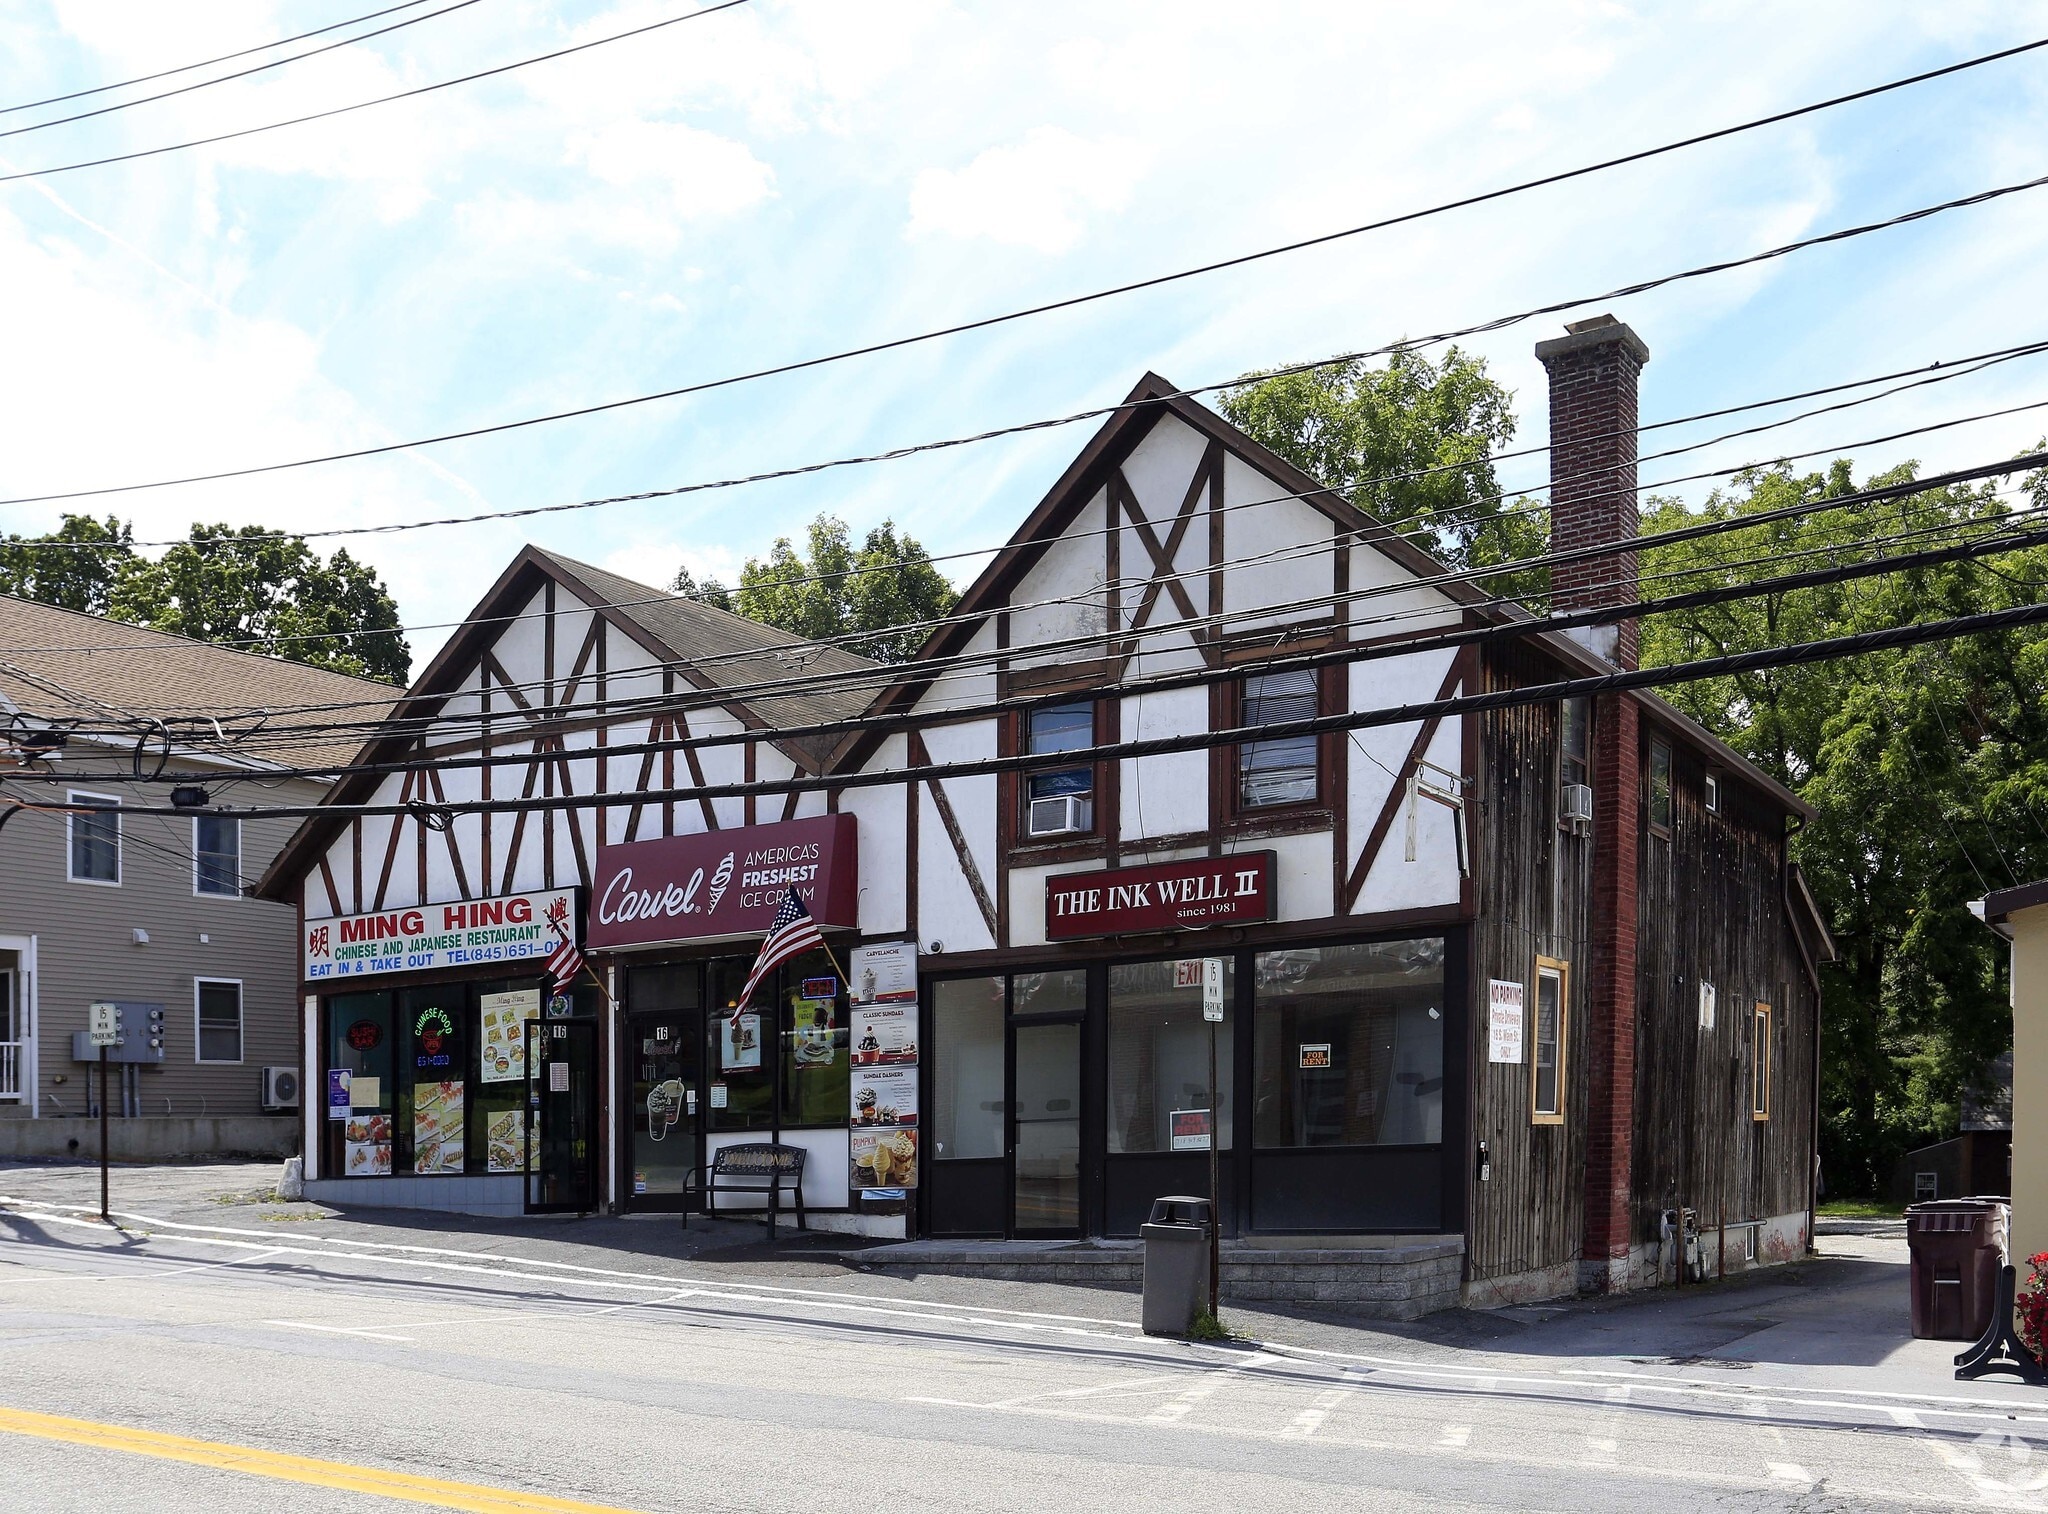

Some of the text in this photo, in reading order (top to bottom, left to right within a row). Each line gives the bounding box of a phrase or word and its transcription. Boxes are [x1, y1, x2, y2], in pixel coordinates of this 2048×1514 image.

[744, 843, 819, 867] AMERICA'S
[741, 865, 818, 887] FRESHEST
[599, 867, 704, 925] Carvel
[740, 887, 815, 908] ICE CRM
[1055, 870, 1259, 916] THE INK WELL II
[1177, 902, 1236, 918] since 1981
[340, 898, 532, 943] MING HING
[334, 925, 541, 961] CHINESE AND JAPANESE RESTAURANT
[310, 963, 332, 977] EAT
[338, 961, 349, 973] IN
[355, 959, 364, 971] &
[371, 956, 401, 970] TAKE
[408, 953, 434, 968] OUT
[1210, 967, 1217, 981] 15
[1209, 986, 1217, 997] MIN
[1491, 983, 1522, 1007] NO PARKING
[1204, 1001, 1222, 1013] PARKING
[414, 1007, 453, 1036] CHINESE FOOD
[91, 1032, 115, 1040] PARKING
[554, 1026, 566, 1038] 16
[657, 1027, 668, 1039] 16
[354, 1037, 375, 1047] BAR
[1303, 1057, 1327, 1065] RENT
[1181, 1114, 1203, 1125] FOR
[1174, 1123, 1210, 1135] RENT
